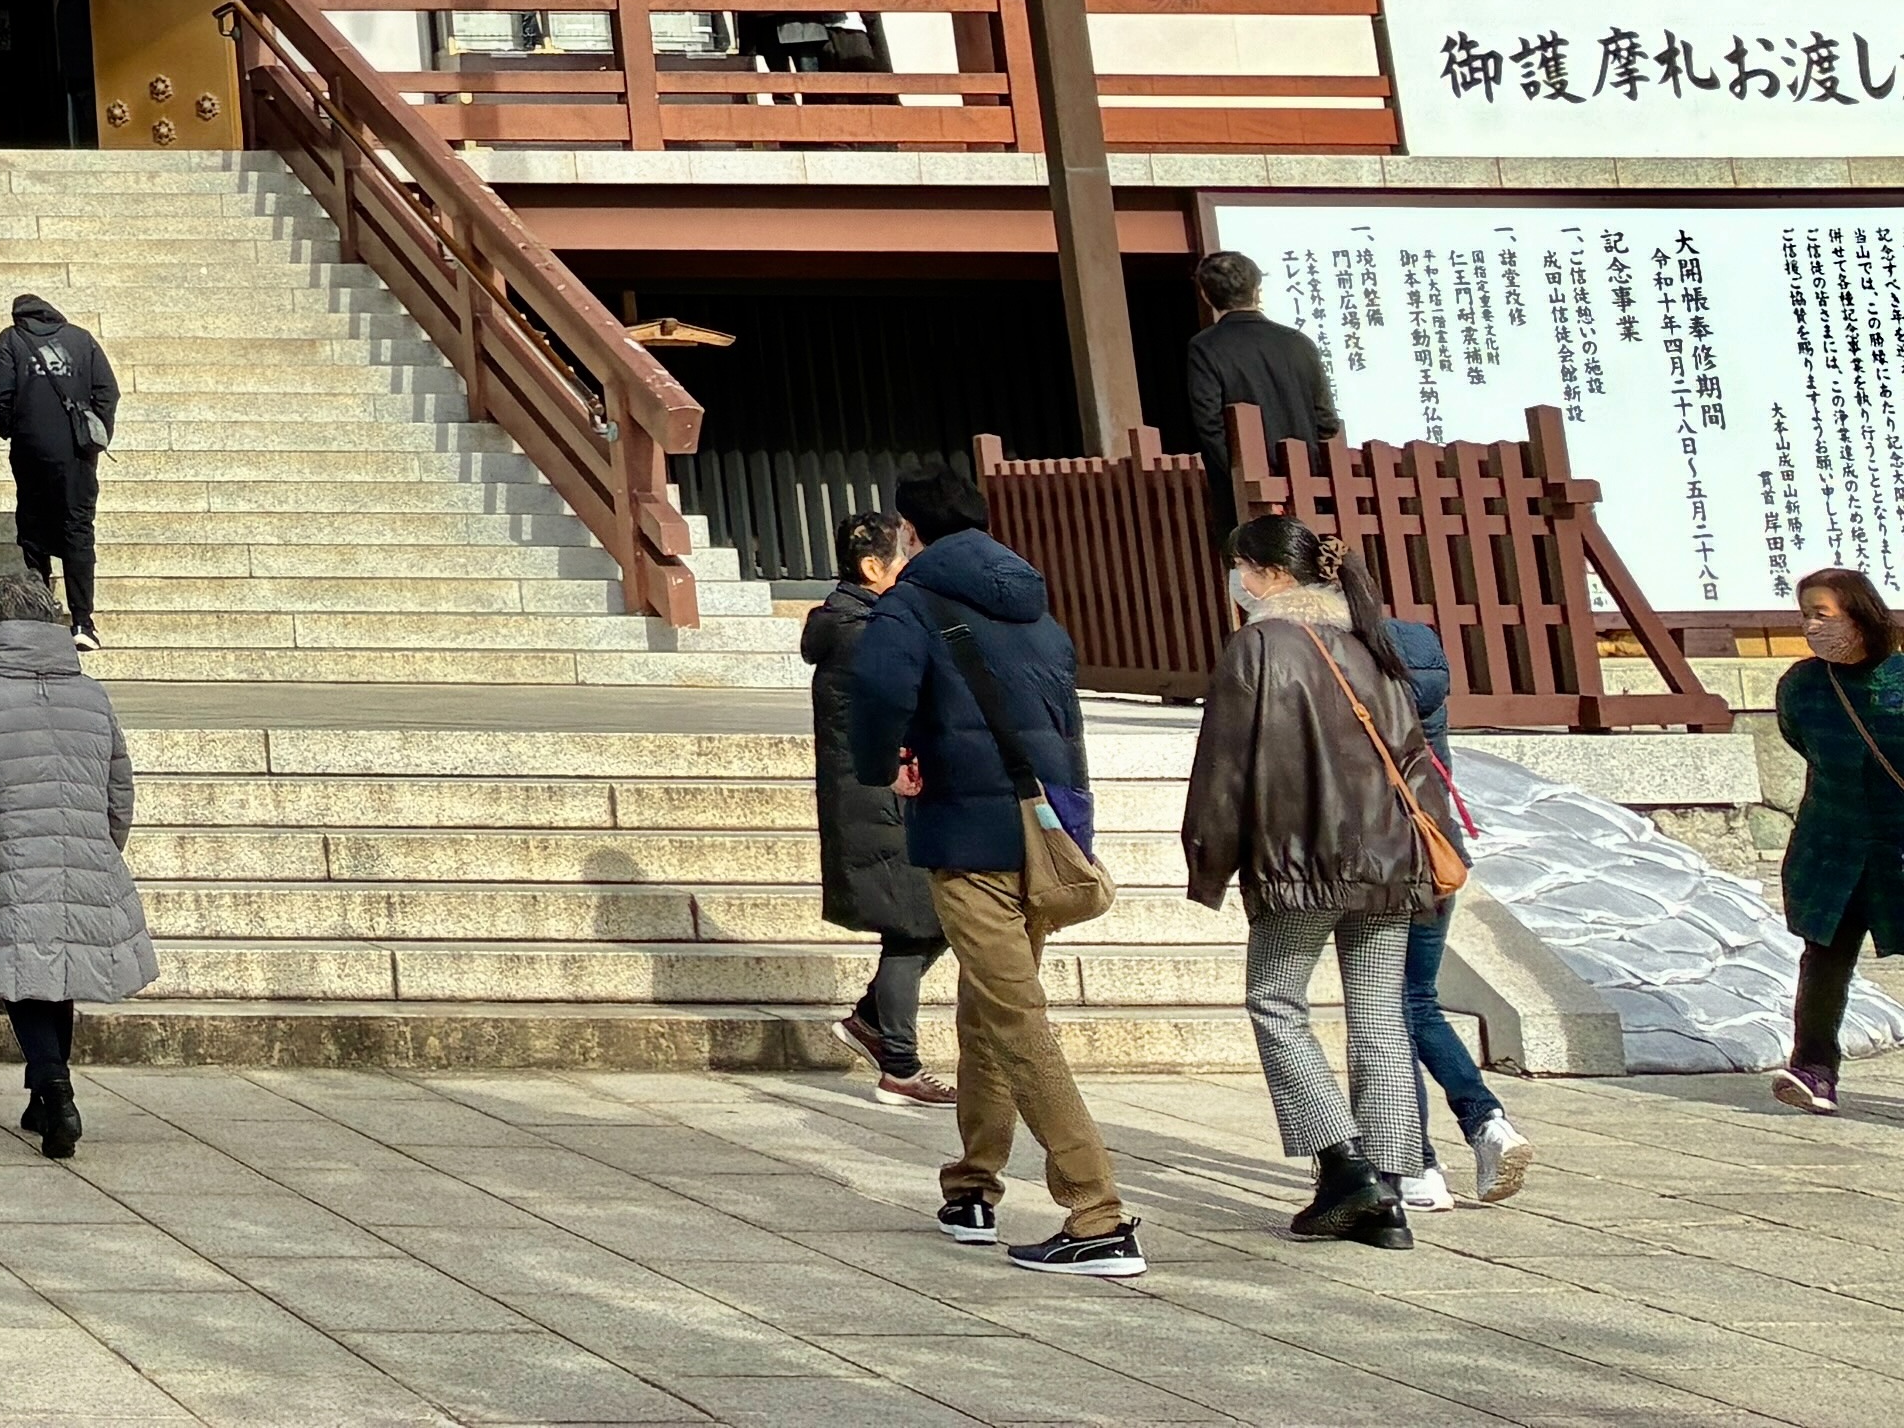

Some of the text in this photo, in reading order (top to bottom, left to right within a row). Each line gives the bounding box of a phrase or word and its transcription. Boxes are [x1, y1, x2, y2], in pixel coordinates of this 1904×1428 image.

[1439, 26, 1904, 106] 御護摩札お渡し
[1331, 249, 1367, 372] 門前広場改修
[1449, 249, 1487, 385] 仁王門耐震補強
[1543, 249, 1586, 423] 成田山信徒会館新設
[1600, 229, 1643, 343] 記念事業
[1675, 229, 1726, 431] 大開帳奉修期間
